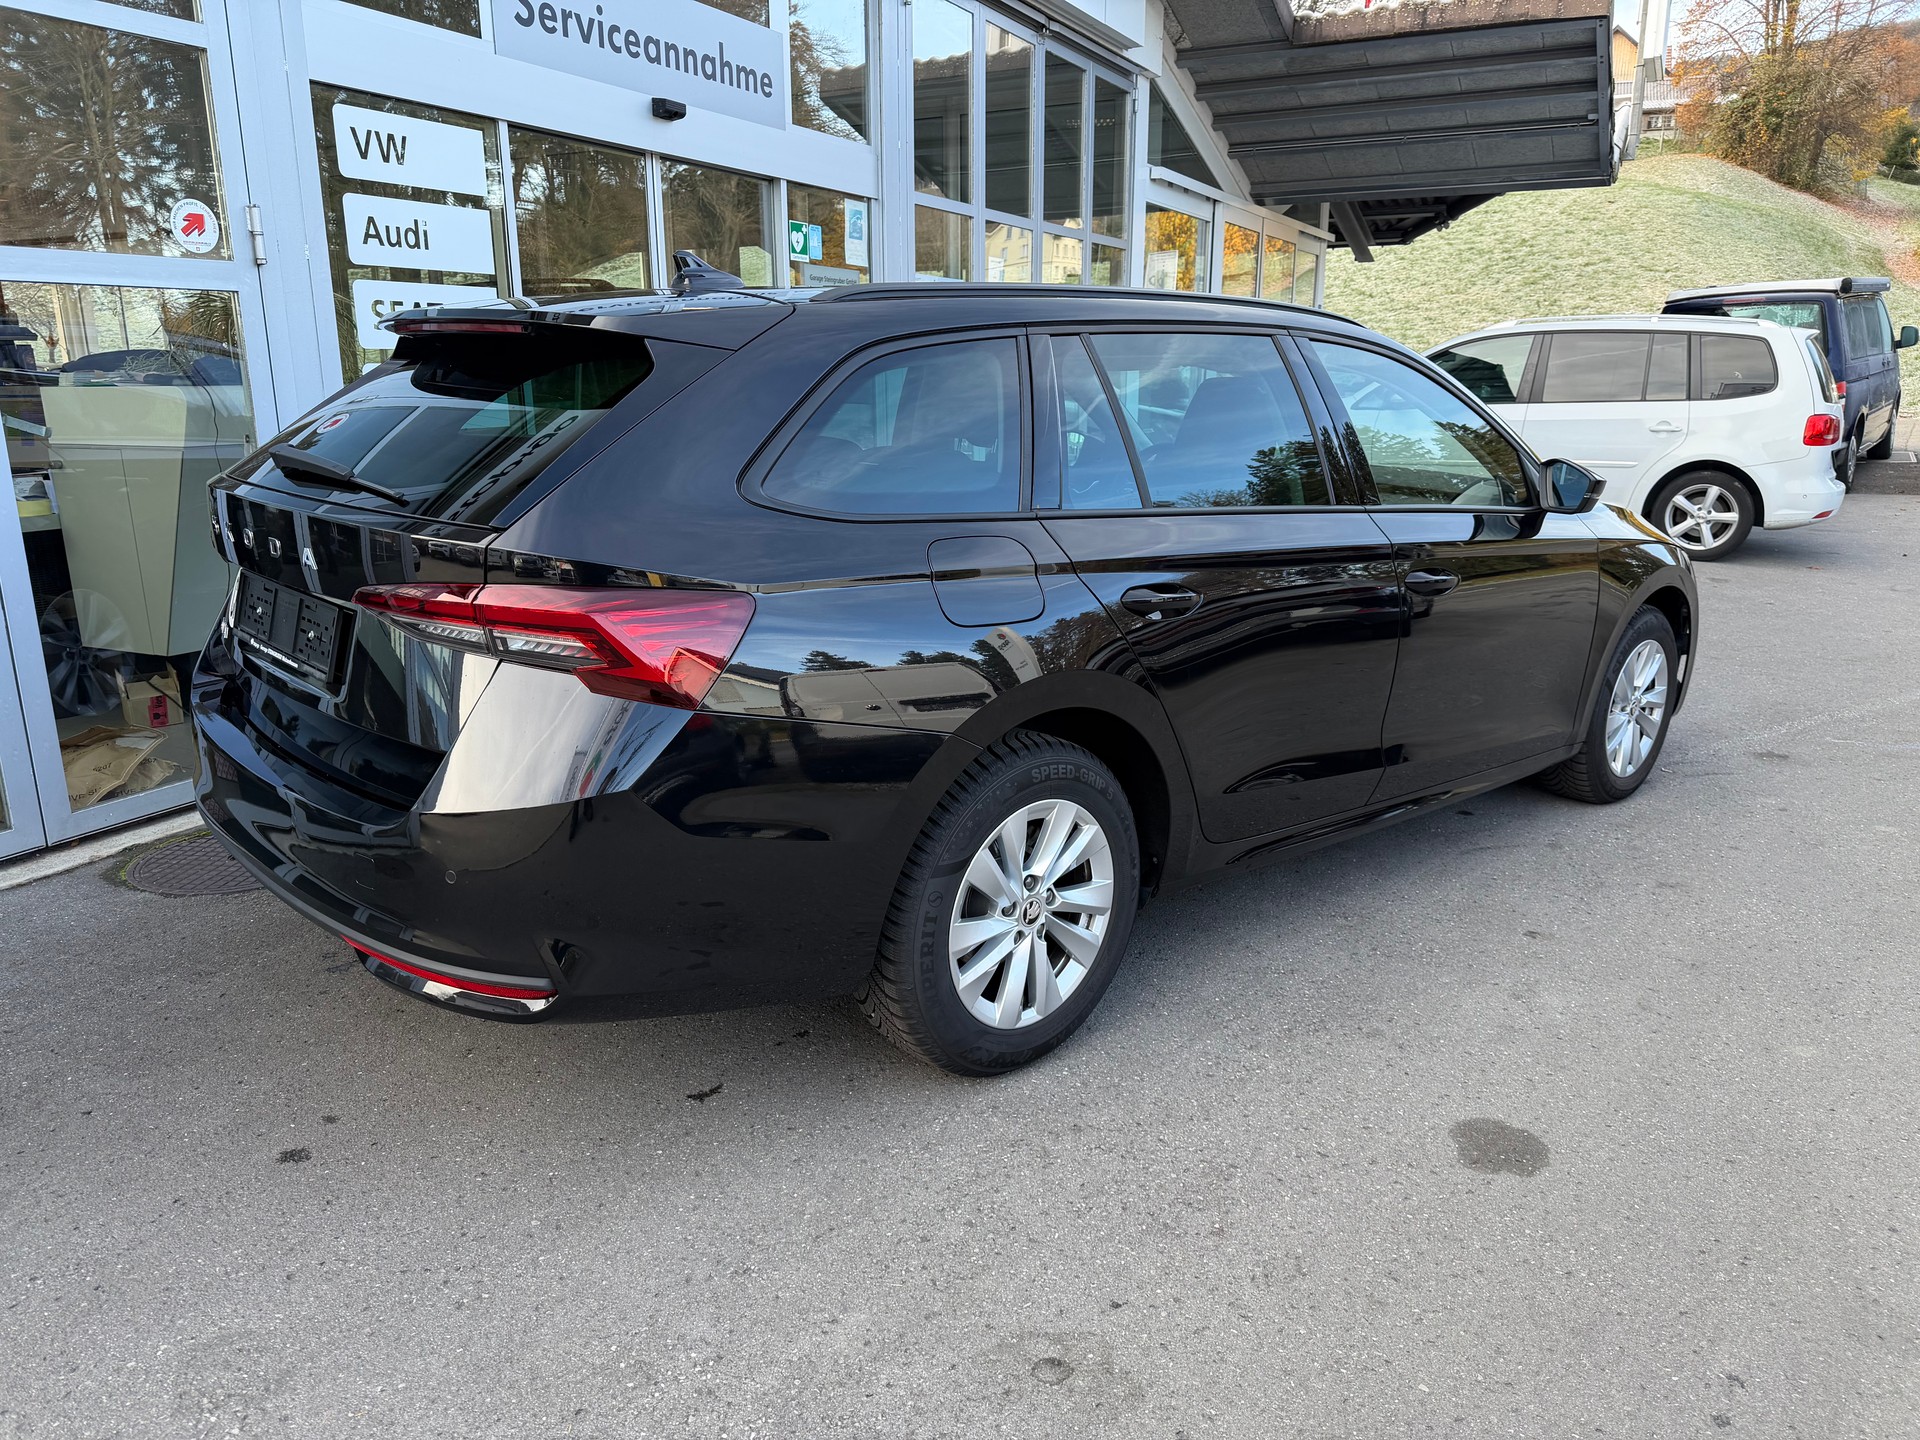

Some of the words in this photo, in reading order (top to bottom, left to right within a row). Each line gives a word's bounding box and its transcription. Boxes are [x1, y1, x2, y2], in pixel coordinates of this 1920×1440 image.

[514, 0, 773, 98] Serviceannahme
[350, 126, 407, 166] VW
[362, 215, 430, 251] Audi
[809, 274, 824, 284] Garage
[1031, 764, 1106, 791] SPEED-GRIP
[1106, 789, 1114, 800] 5
